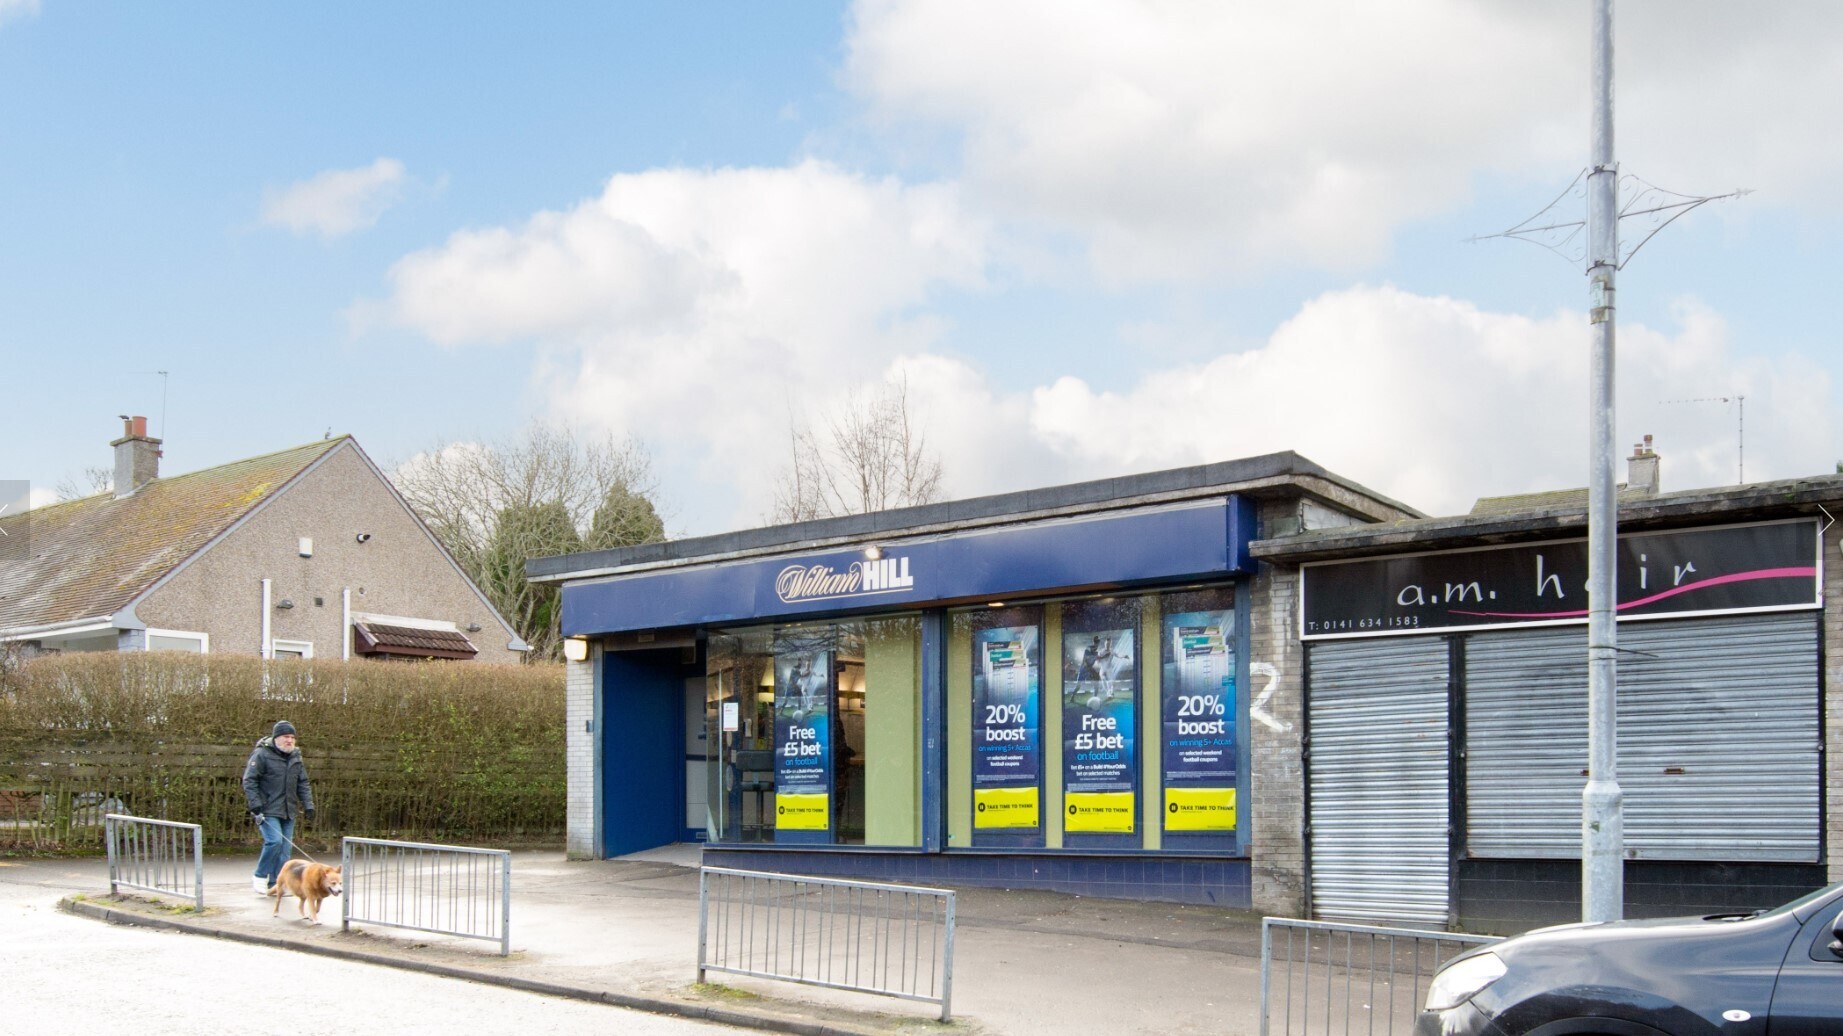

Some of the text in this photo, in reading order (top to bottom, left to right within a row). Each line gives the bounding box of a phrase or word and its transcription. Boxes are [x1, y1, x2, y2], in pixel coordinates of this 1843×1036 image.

[776, 557, 914, 602] William HILL
[1398, 554, 1697, 606] a.m. hir
[1308, 616, 1418, 630] T: 0141 634 1583
[1178, 695, 1225, 716] 20%
[986, 704, 1026, 724] 20%
[1082, 714, 1116, 730] Free
[790, 726, 816, 740] Free
[986, 726, 1025, 741] boost
[1179, 719, 1225, 735] boost
[784, 741, 821, 756] £5 bet
[1075, 733, 1124, 750] £5 bet
[795, 757, 818, 766] football
[1089, 751, 1118, 760] football
